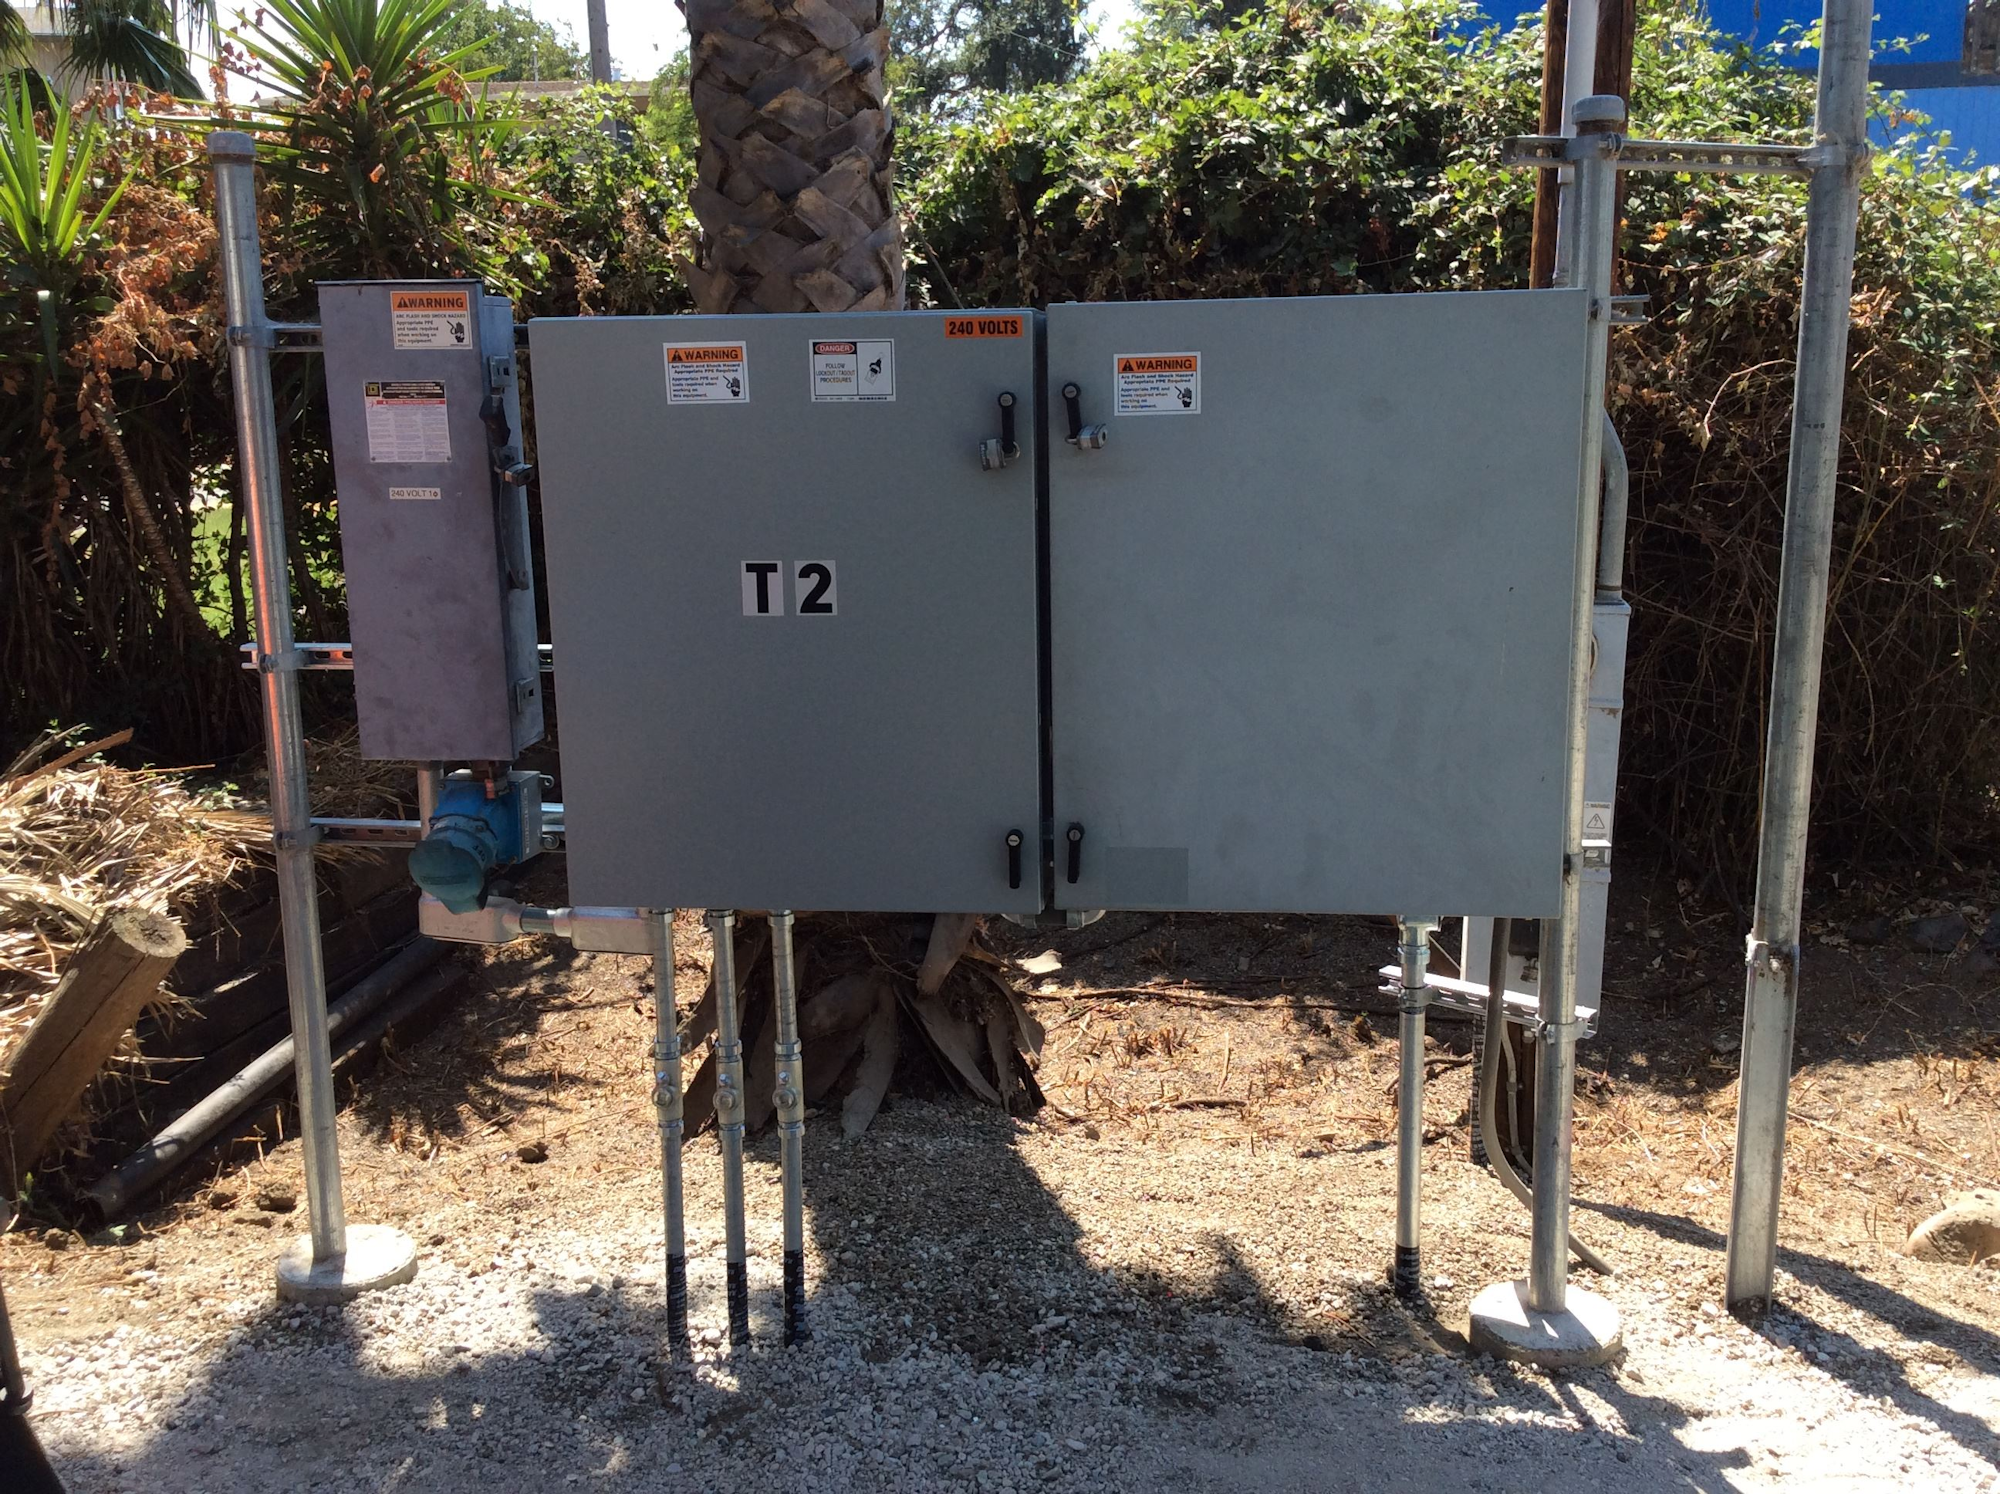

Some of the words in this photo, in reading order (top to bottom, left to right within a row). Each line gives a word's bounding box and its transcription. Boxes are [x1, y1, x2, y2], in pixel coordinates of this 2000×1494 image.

[408, 297, 464, 308] WARNING
[949, 321, 974, 335] 240
[978, 320, 1018, 334] VOLTS
[685, 350, 739, 360] WARNING
[1136, 359, 1192, 370] WARNING
